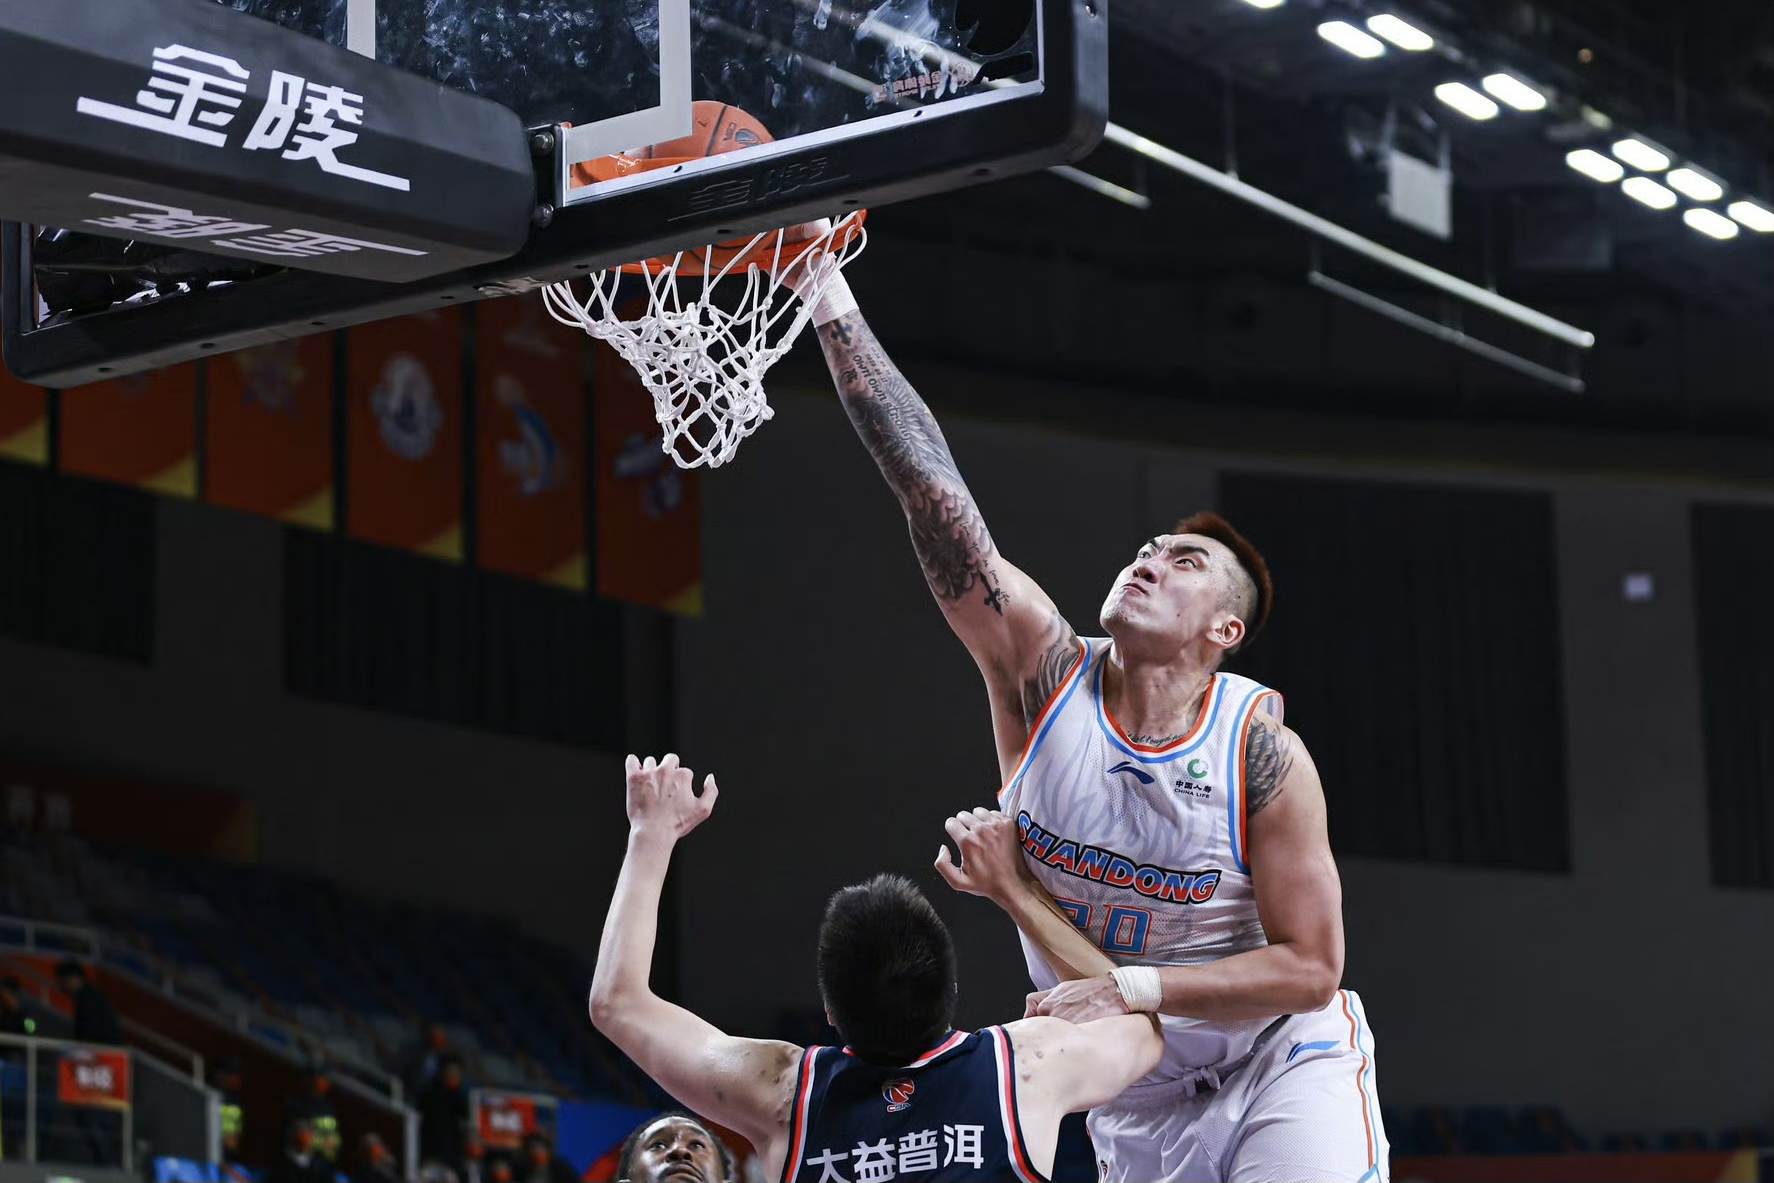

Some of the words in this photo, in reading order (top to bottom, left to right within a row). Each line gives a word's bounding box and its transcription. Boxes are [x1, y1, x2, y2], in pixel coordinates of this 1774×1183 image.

[76, 43, 411, 192] 金陵
[1174, 788, 1194, 797] CHINA
[1176, 780, 1212, 794] 中国人寿
[1017, 810, 1222, 905] SHANDONG
[806, 1124, 985, 1183] 大益普洱
